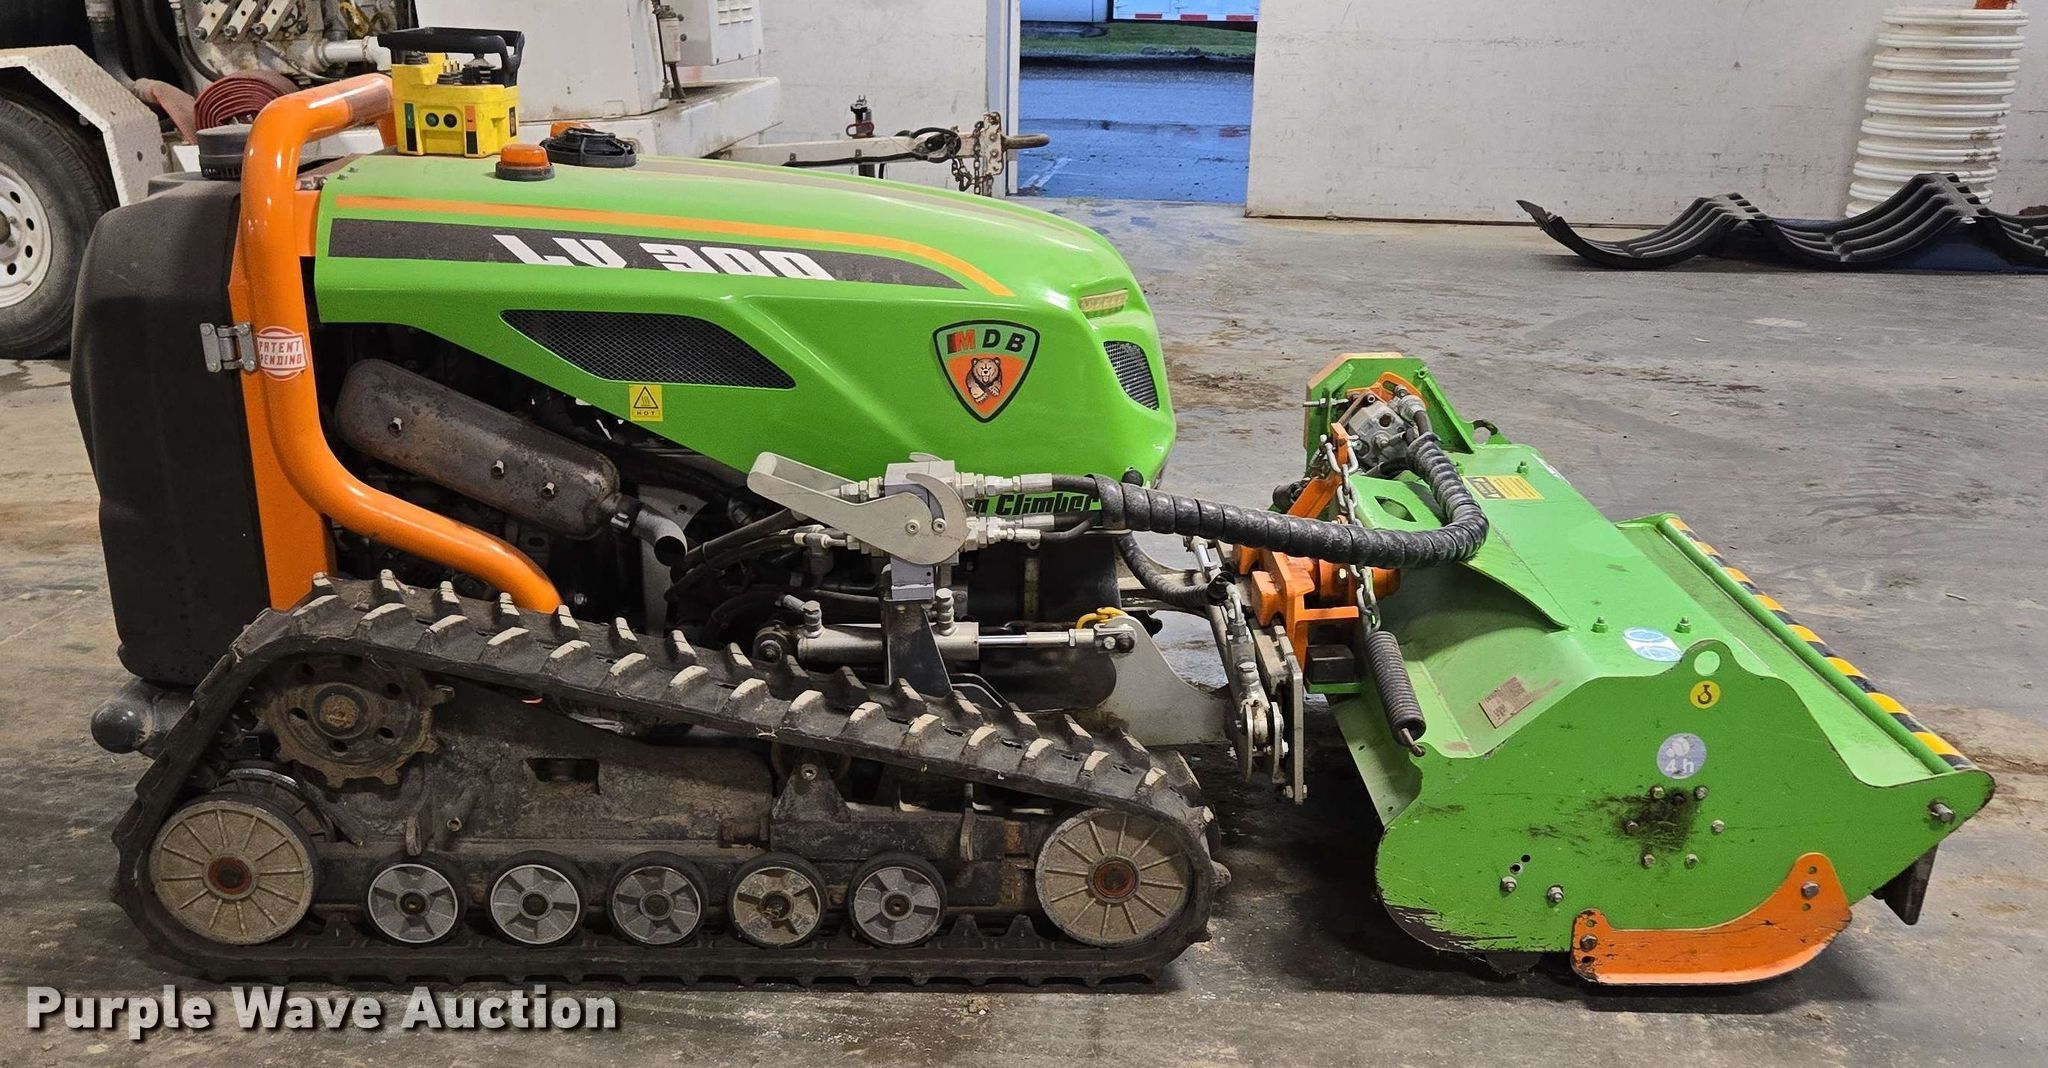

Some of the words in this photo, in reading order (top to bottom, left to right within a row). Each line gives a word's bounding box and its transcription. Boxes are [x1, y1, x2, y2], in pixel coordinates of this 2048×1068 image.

[639, 243, 835, 281] 300
[259, 341, 300, 353] PATENT
[947, 329, 1025, 354] MDB
[260, 354, 303, 366] PENDING
[996, 493, 1102, 516] Climber
